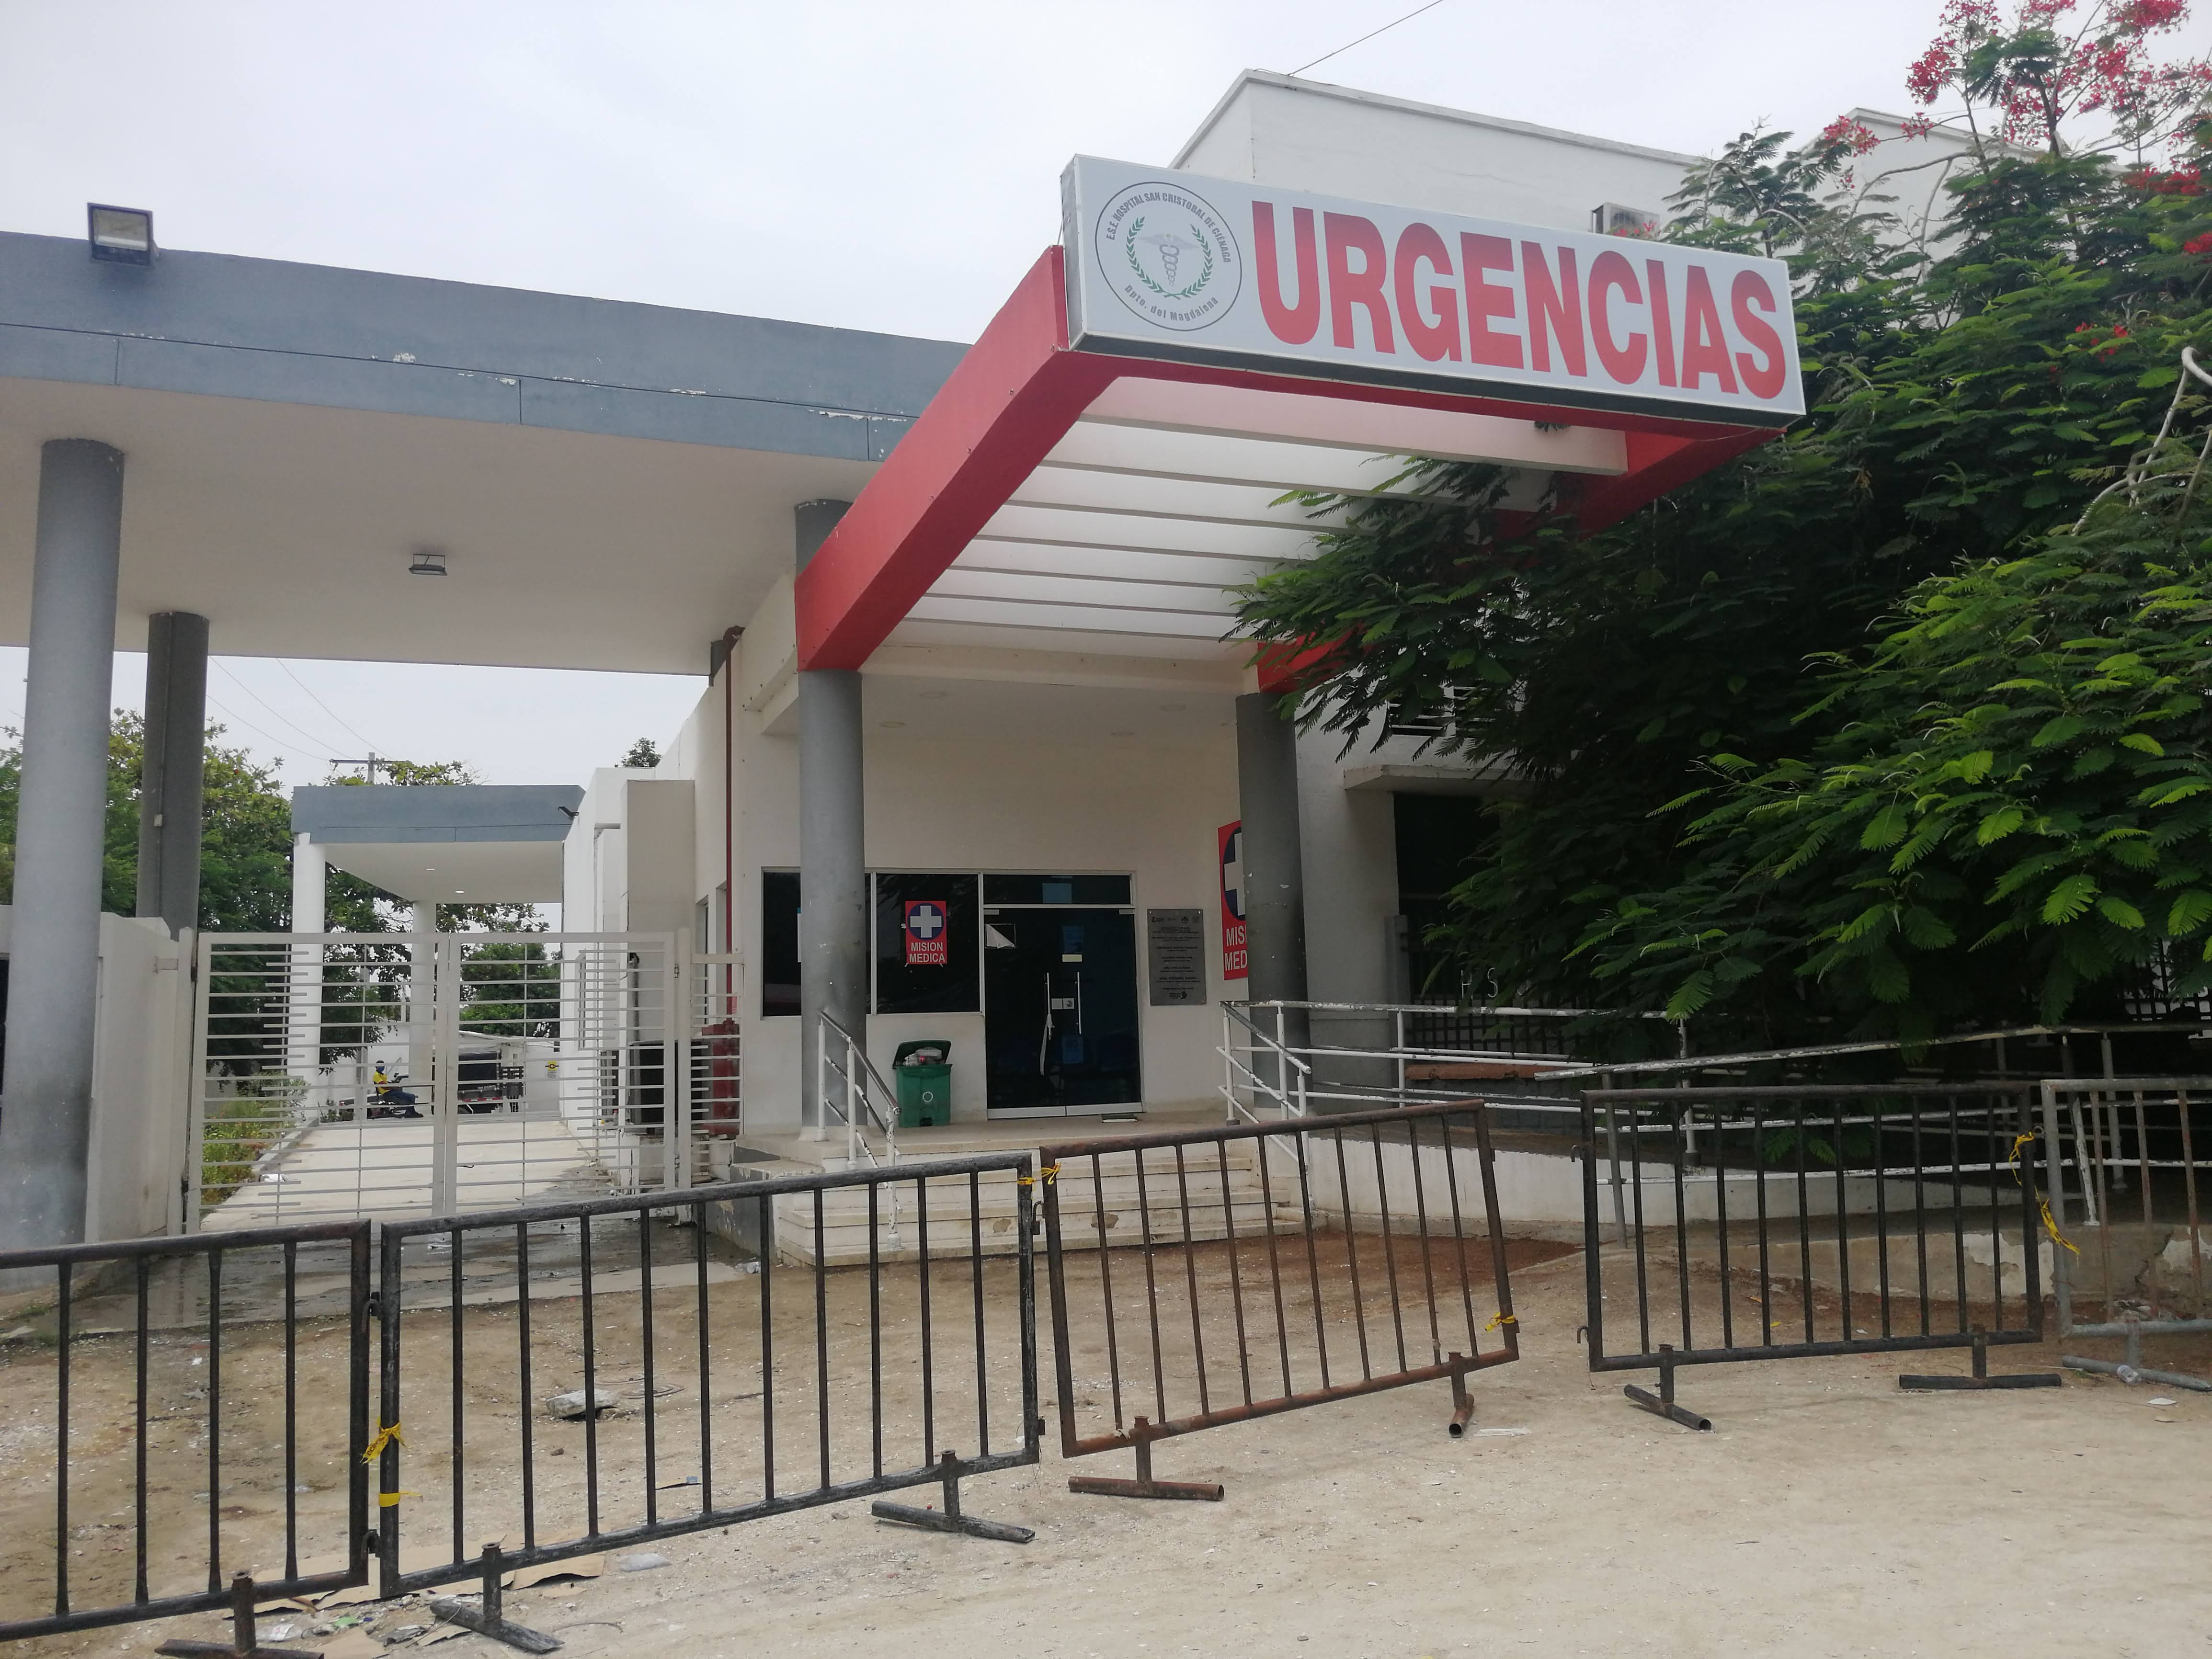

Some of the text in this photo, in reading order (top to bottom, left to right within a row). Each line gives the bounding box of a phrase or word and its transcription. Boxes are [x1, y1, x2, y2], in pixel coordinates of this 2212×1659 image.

[1112, 194, 1145, 221] HOSPITAL
[1143, 192, 1161, 202] SAN
[1162, 193, 1206, 220] CRISTOBAL
[1204, 217, 1216, 228] DE
[1124, 284, 1219, 321] Dpto. del Magdalena
[1252, 200, 1786, 399] URGENCIAS
[910, 953, 945, 963] MEDICA
[911, 942, 943, 952] MISION
